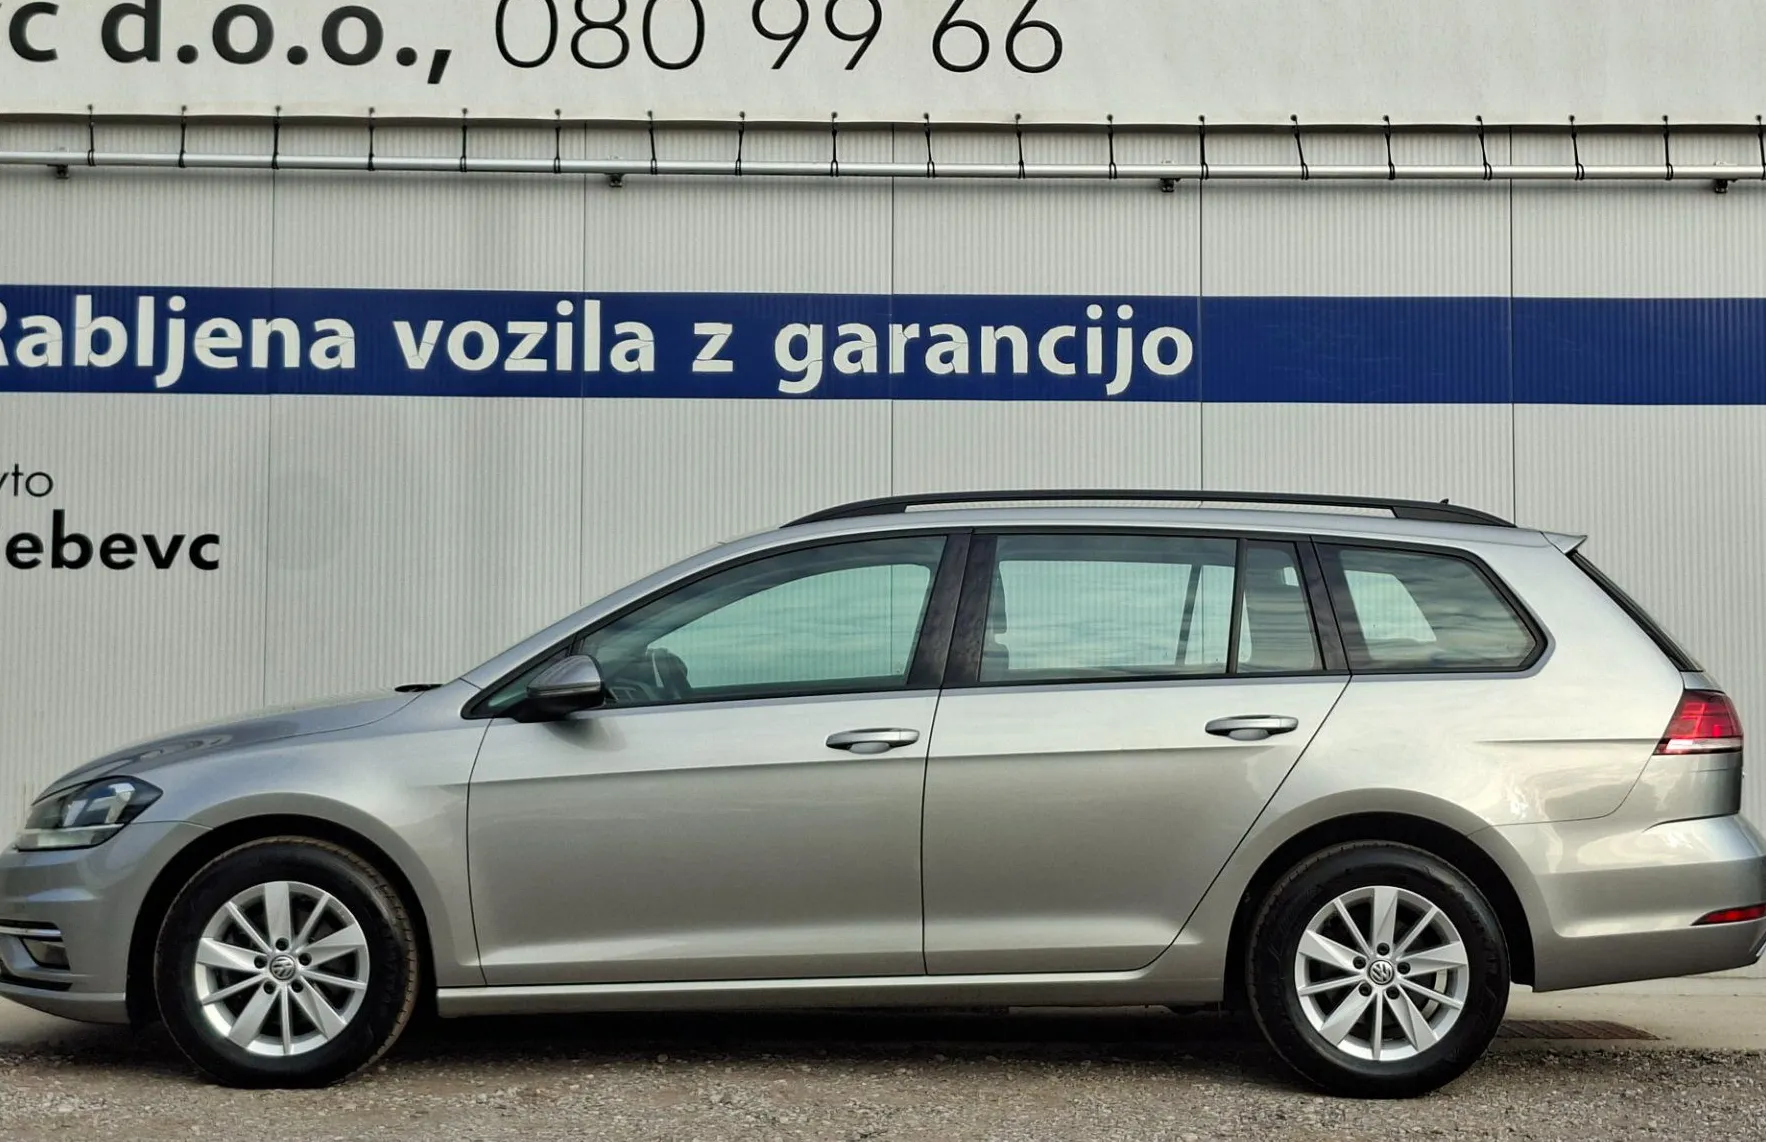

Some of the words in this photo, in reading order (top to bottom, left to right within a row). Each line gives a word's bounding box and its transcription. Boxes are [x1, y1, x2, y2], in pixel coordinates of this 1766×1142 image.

[0, 1, 59, 63] c
[100, 0, 452, 85] d.o.o.,
[495, 0, 705, 71] 080
[751, 0, 883, 71] 99
[932, 0, 1063, 74] 66
[0, 294, 356, 389] abljena
[392, 299, 655, 373] vozila
[691, 322, 734, 373] z
[774, 304, 1193, 393] garancijo
[5, 508, 220, 571] ebevc
